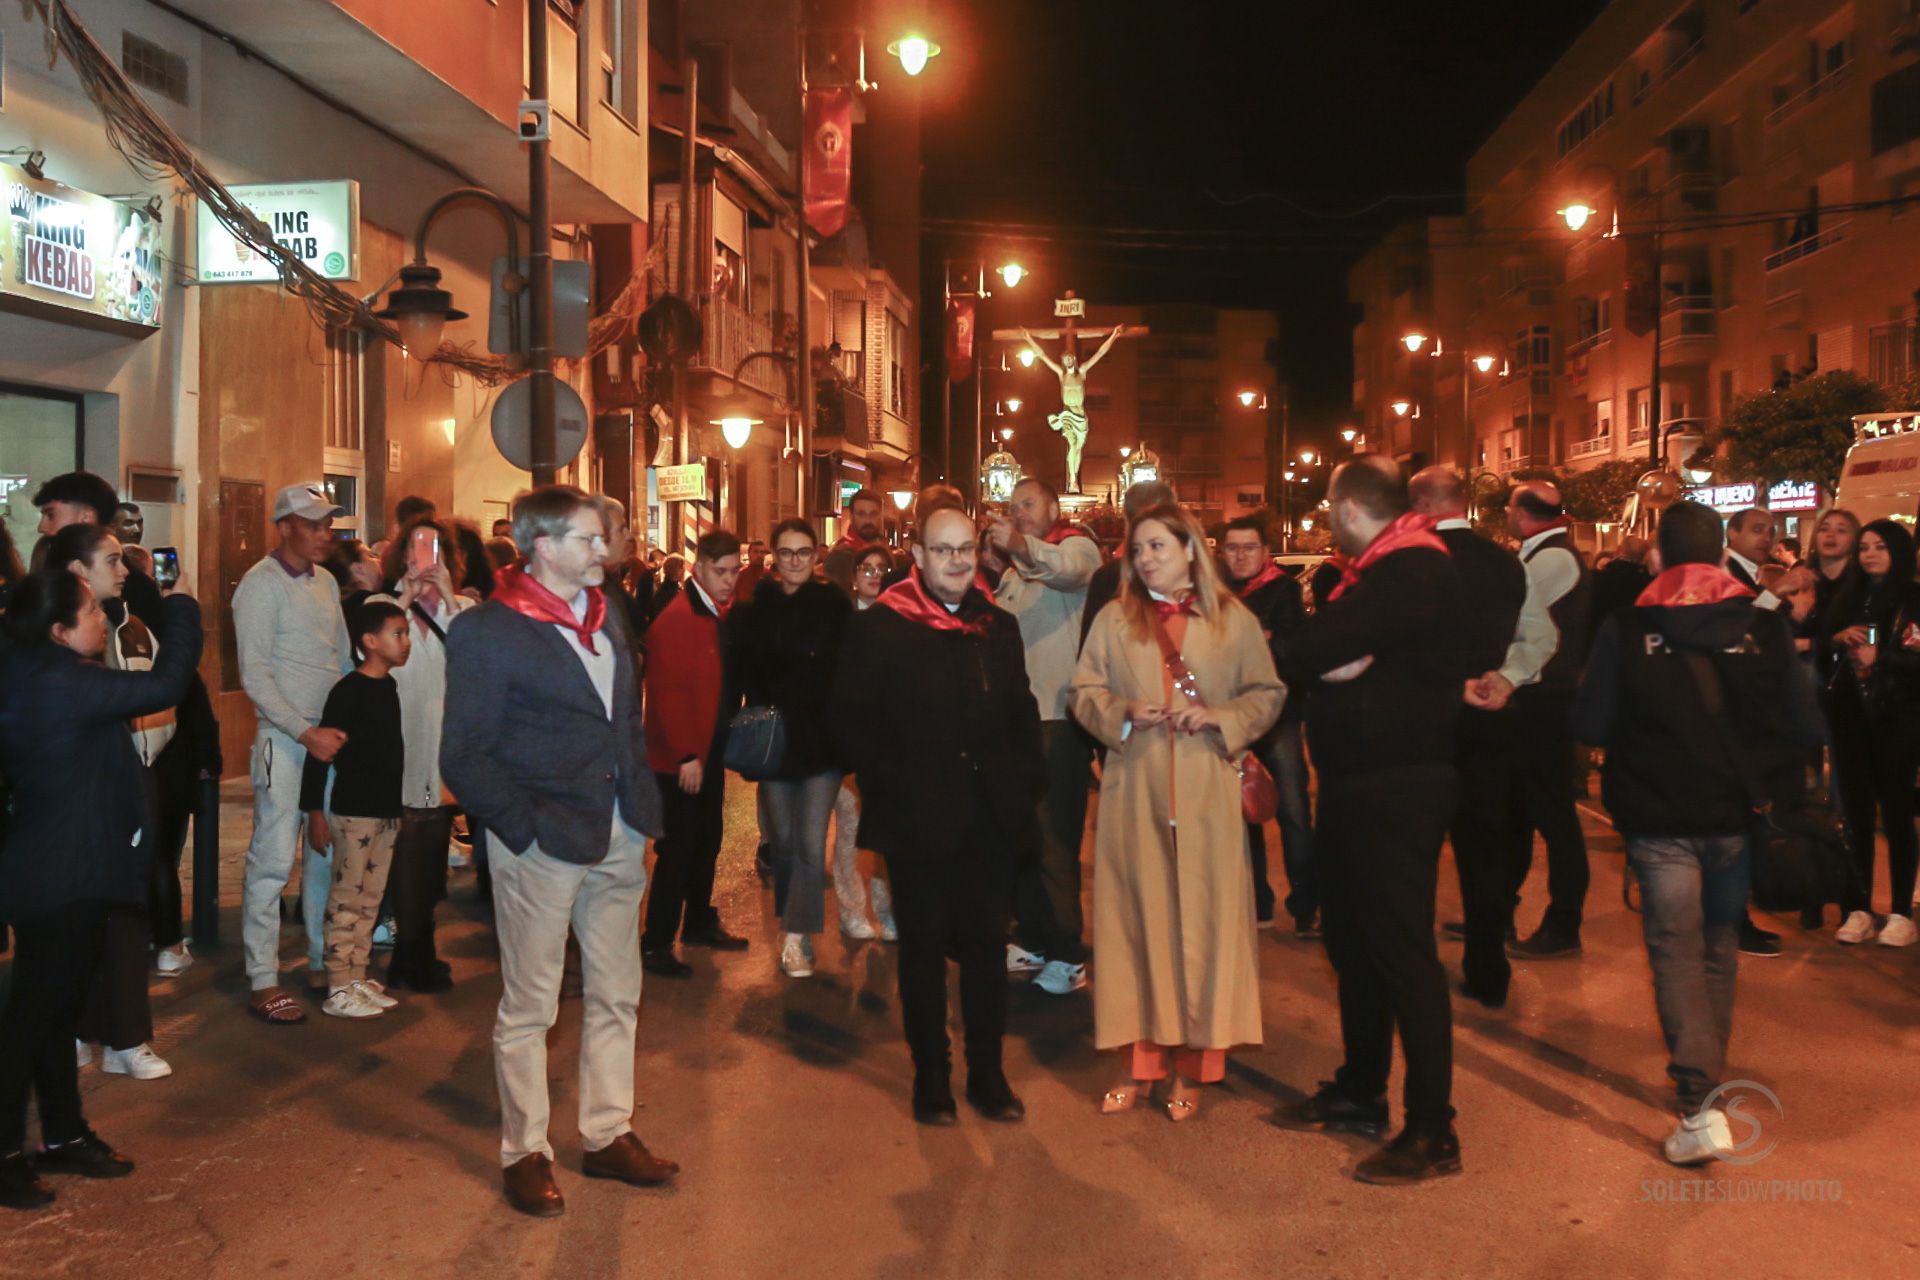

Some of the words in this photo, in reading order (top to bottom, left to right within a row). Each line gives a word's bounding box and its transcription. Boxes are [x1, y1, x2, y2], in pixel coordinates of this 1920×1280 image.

[36, 194, 85, 250] KING
[27, 237, 93, 296] KEBAB
[1060, 303, 1080, 314] INRI
